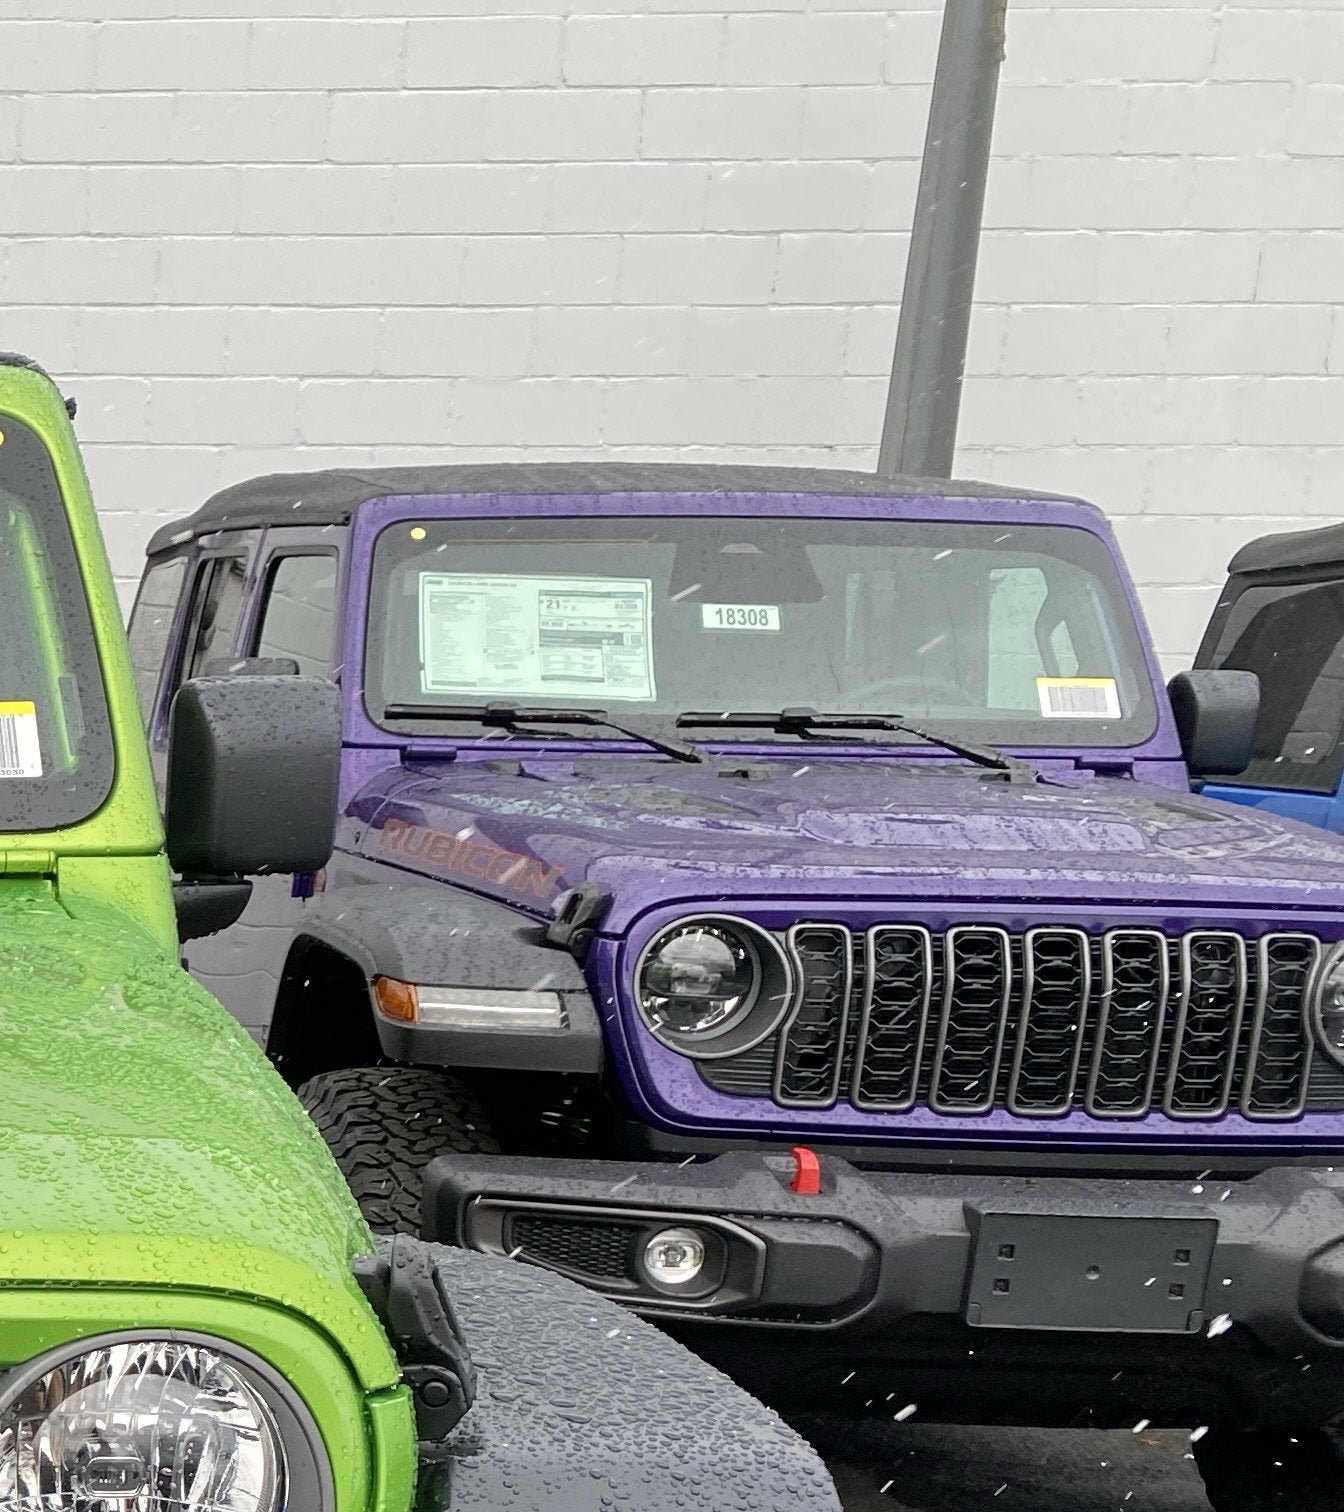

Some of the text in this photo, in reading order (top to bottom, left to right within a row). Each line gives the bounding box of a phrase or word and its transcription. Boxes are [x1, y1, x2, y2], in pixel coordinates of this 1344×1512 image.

[546, 599, 560, 609] 21
[715, 607, 769, 626] 18308
[378, 817, 566, 899] RUBICON
